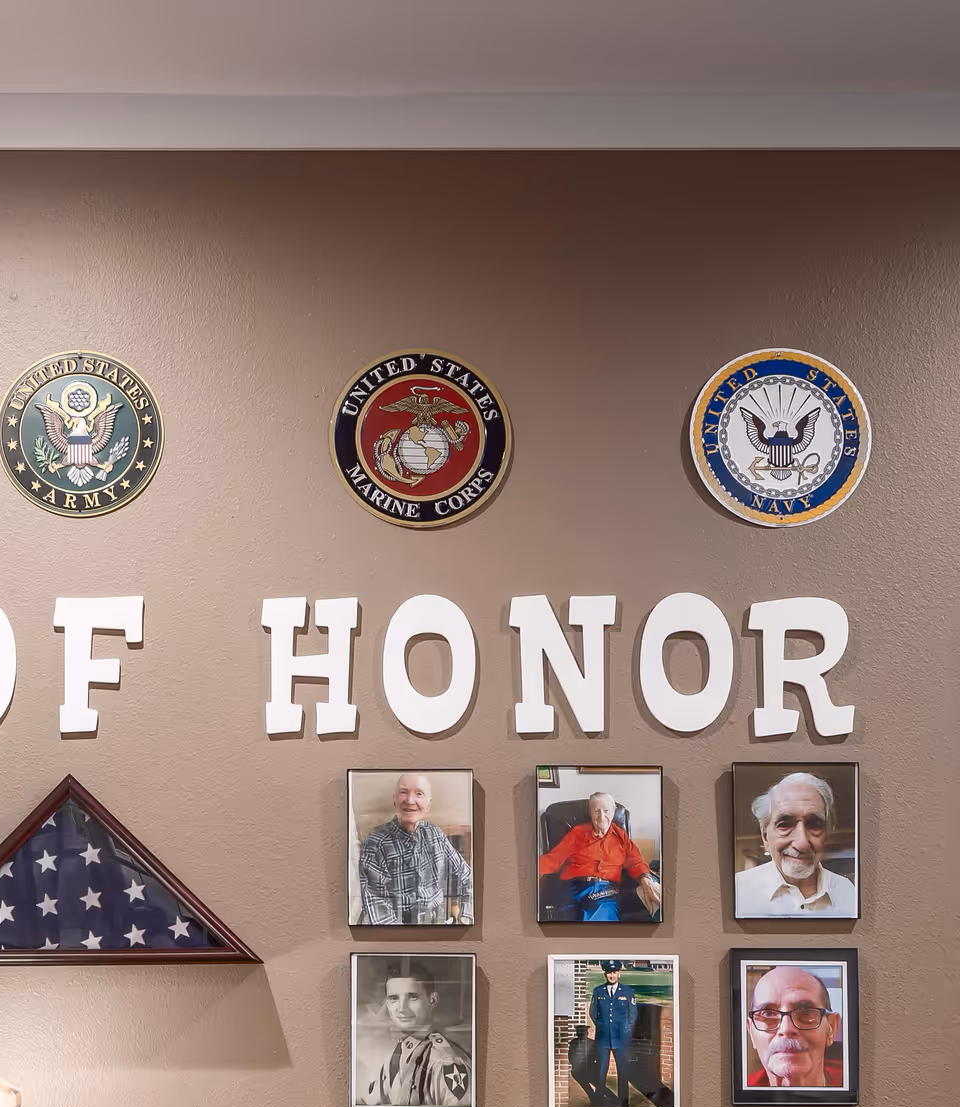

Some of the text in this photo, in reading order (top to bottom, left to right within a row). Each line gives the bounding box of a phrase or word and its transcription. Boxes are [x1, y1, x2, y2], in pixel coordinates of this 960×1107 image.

[9, 358, 150, 411] UNITED STATES
[342, 357, 500, 421] UNITED STATES
[705, 367, 858, 457] UNITED STATES
[42, 486, 118, 509] ARMY
[345, 463, 494, 518] MARINE CORPS
[751, 494, 811, 513] NAVY
[261, 592, 855, 737] HONOR
